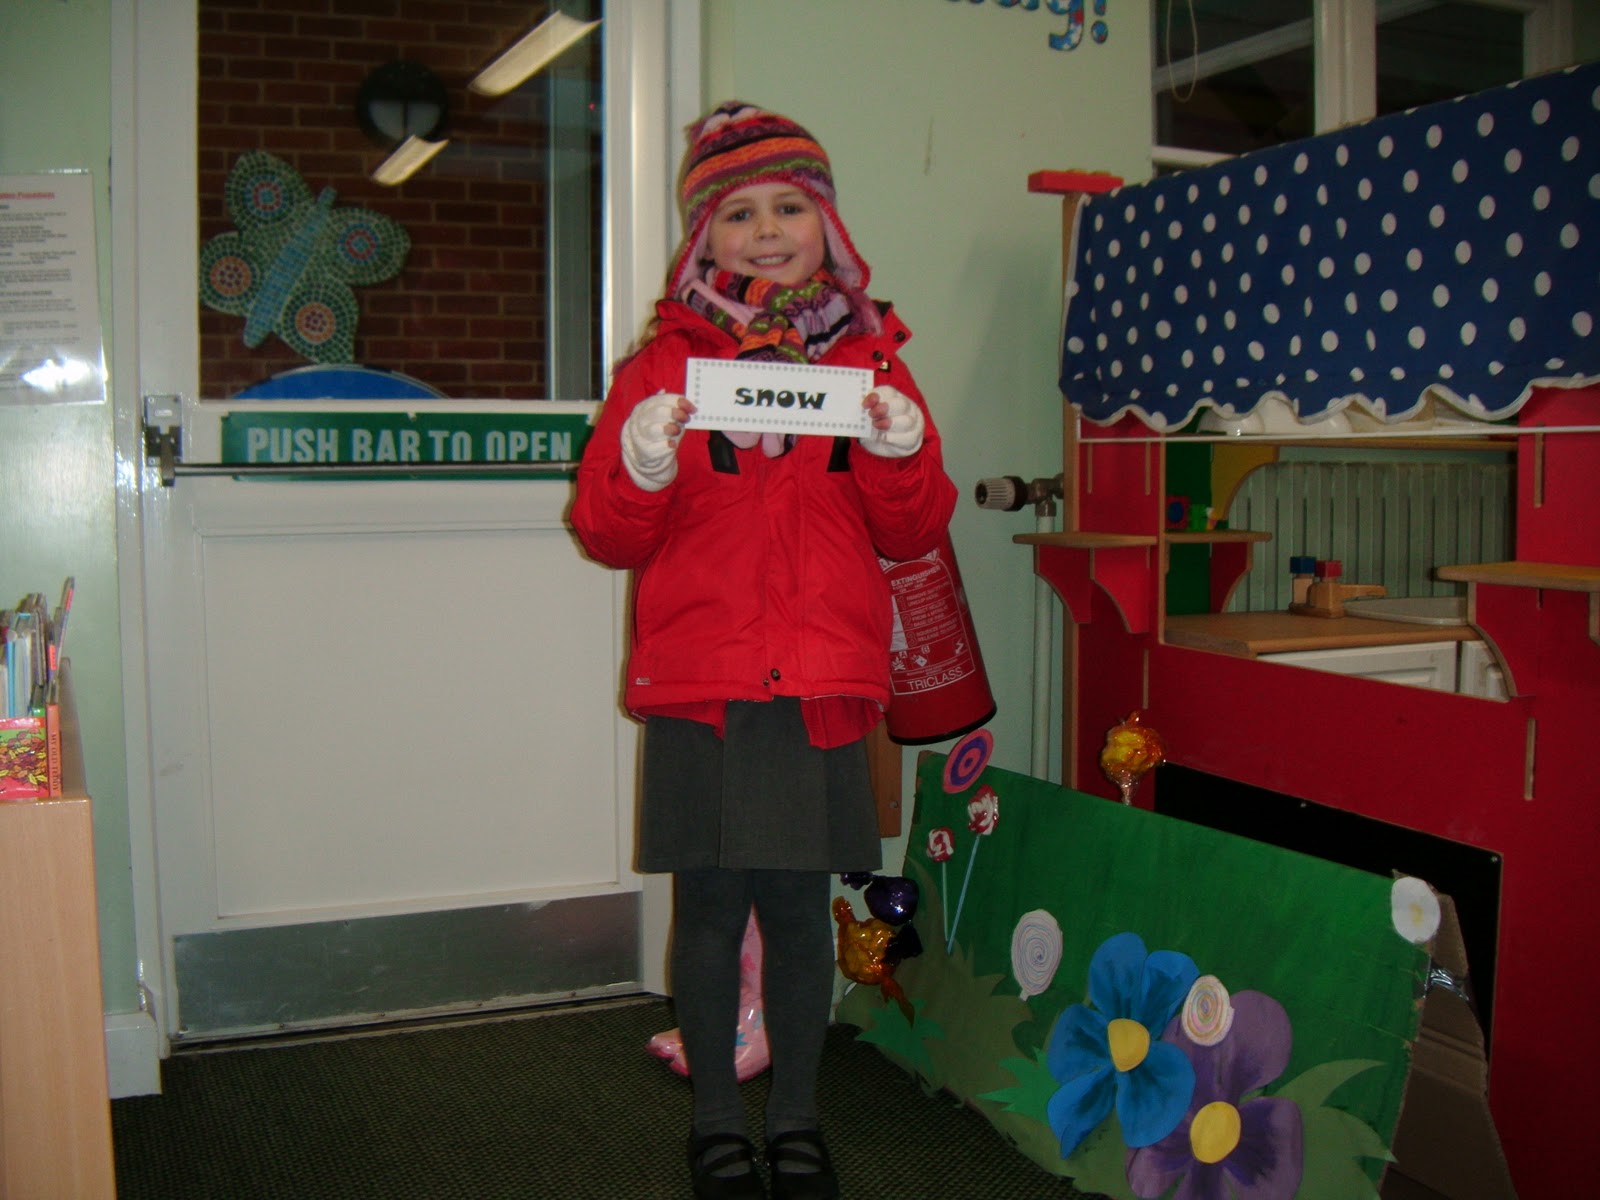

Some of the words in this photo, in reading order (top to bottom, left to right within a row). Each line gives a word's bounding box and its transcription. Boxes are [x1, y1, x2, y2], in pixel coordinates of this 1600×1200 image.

[247, 427, 338, 463] PUSH
[352, 429, 421, 463] BAR
[429, 430, 472, 461] TO
[486, 431, 571, 461] OPEN
[891, 565, 941, 587] EXTINGUISHER
[907, 666, 963, 690] TRICLASS
